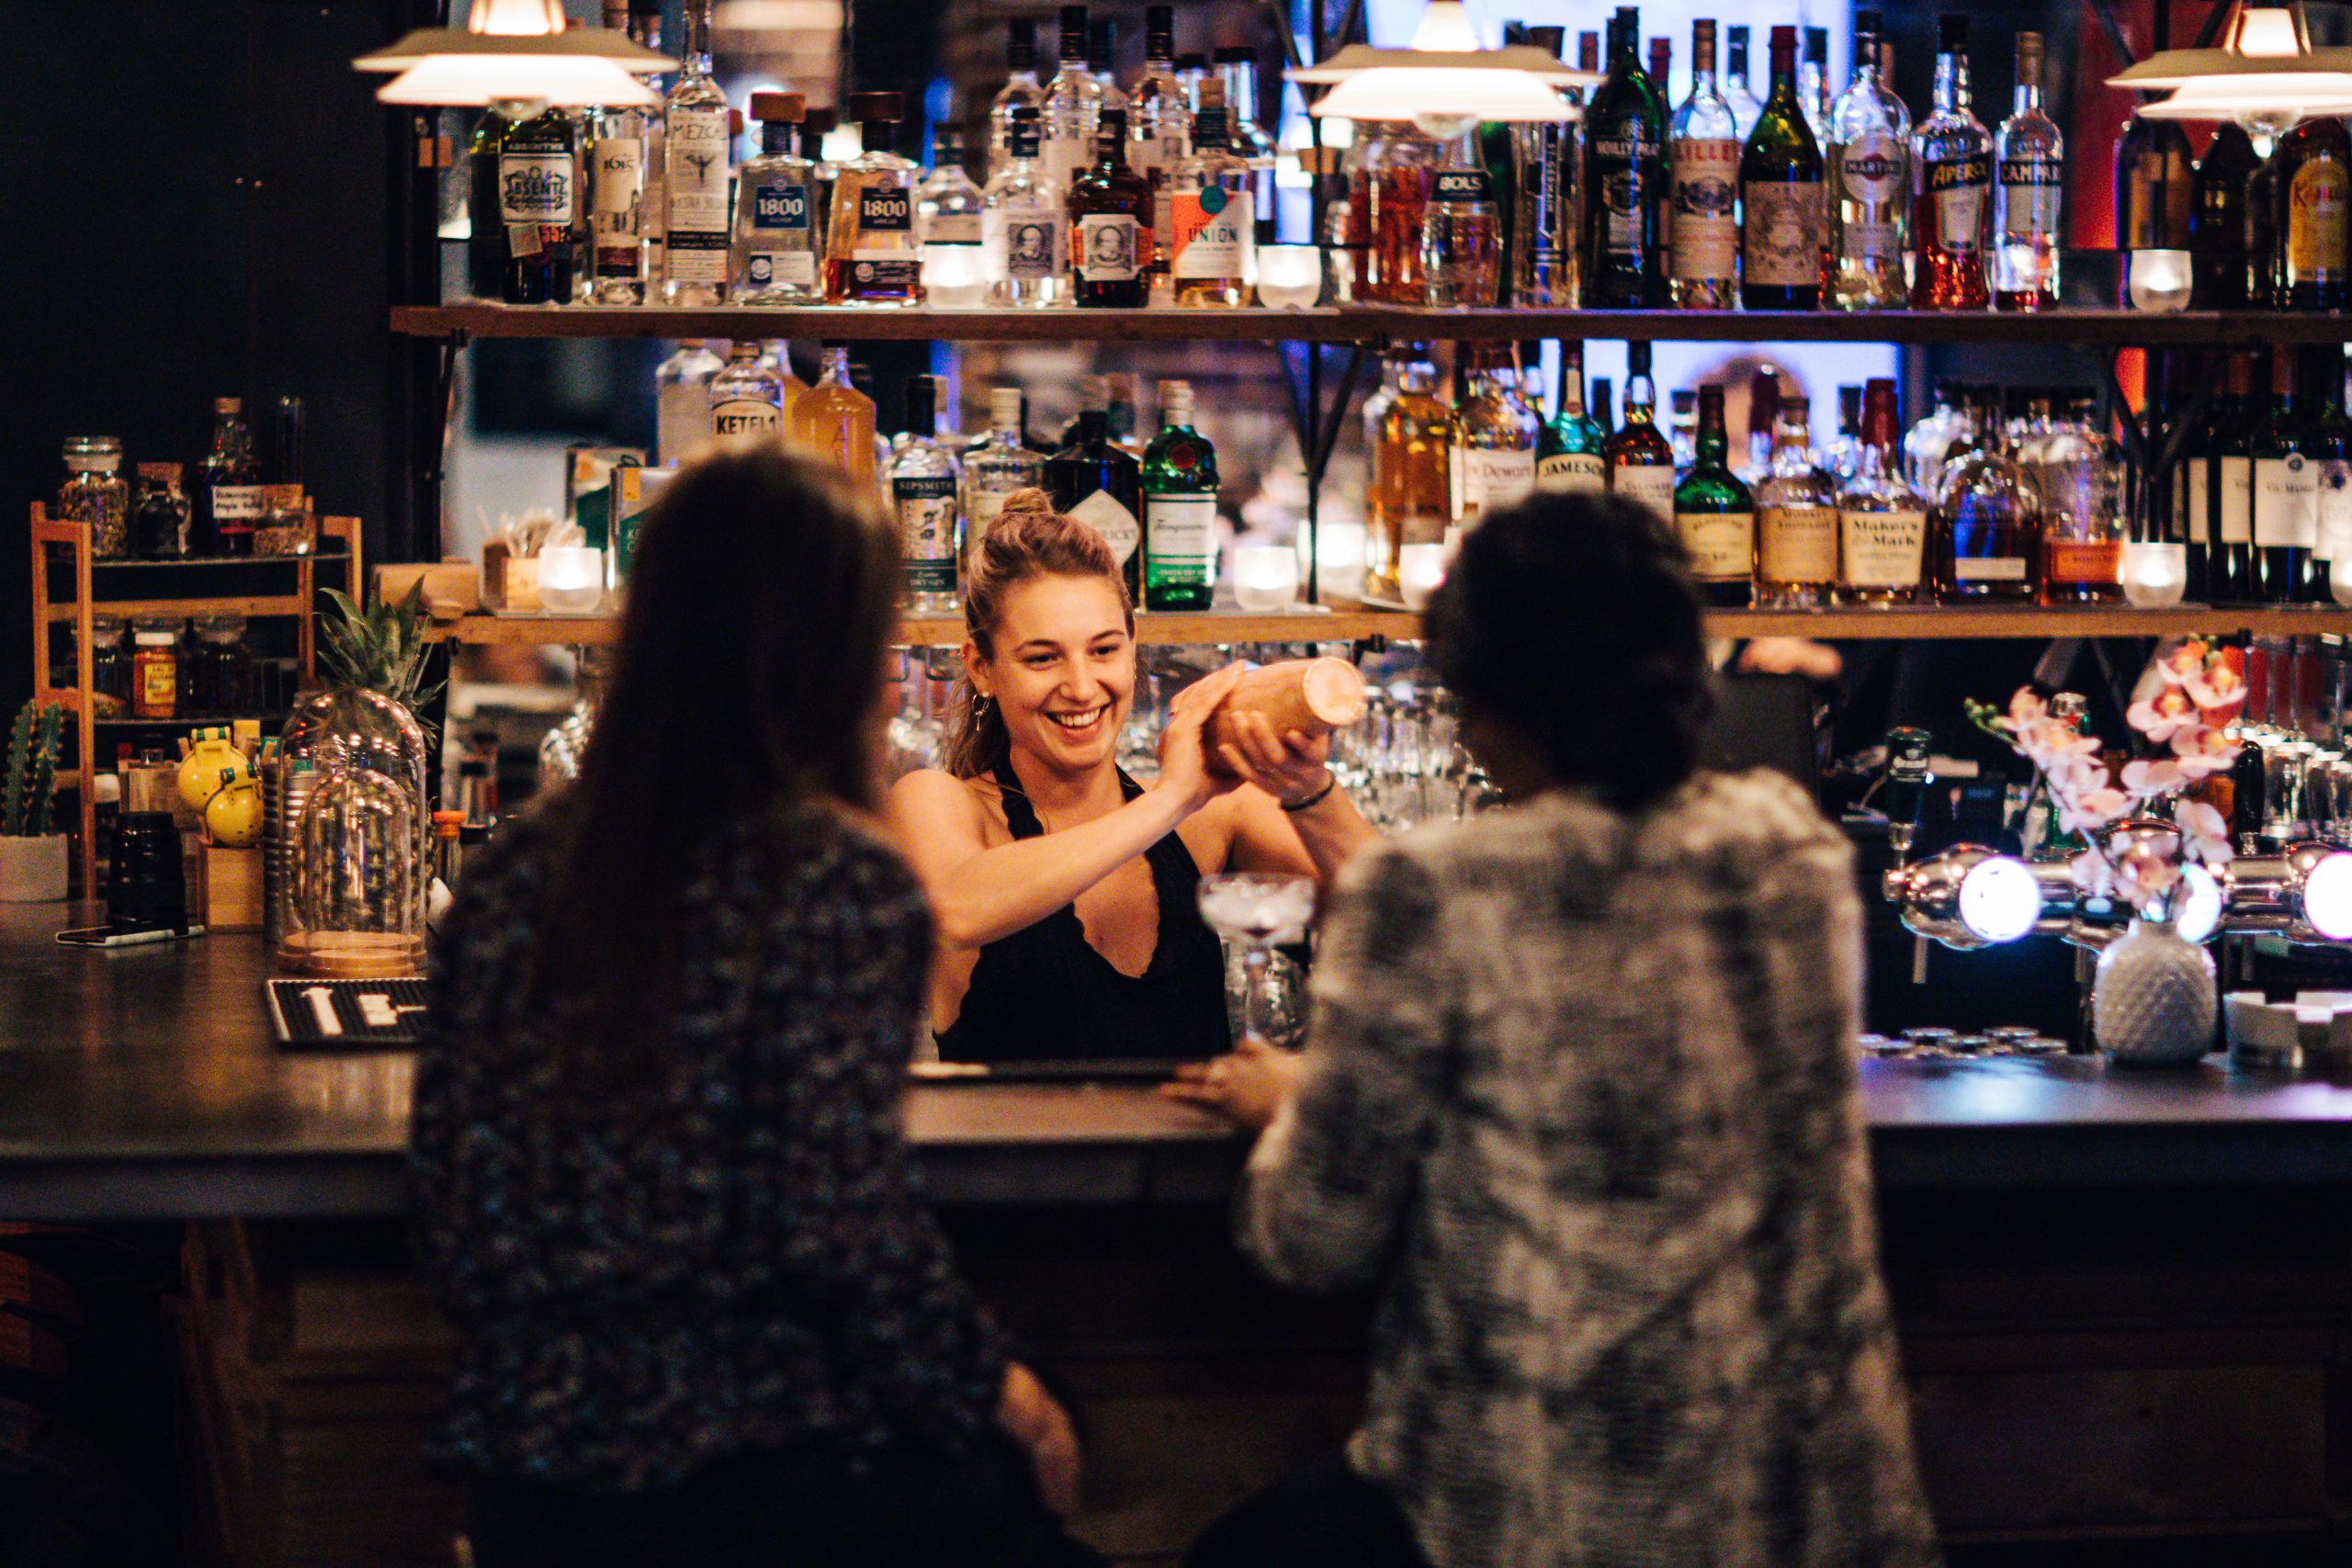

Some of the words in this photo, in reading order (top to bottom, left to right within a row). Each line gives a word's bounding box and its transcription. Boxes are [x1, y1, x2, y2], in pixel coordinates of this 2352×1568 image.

[1439, 176, 1482, 190] BOLS
[759, 198, 803, 216] 1800
[864, 199, 907, 217] 1800
[1188, 227, 1238, 243] UNION
[1853, 519, 1918, 532] Maker's
[1874, 535, 1915, 547] Mark
